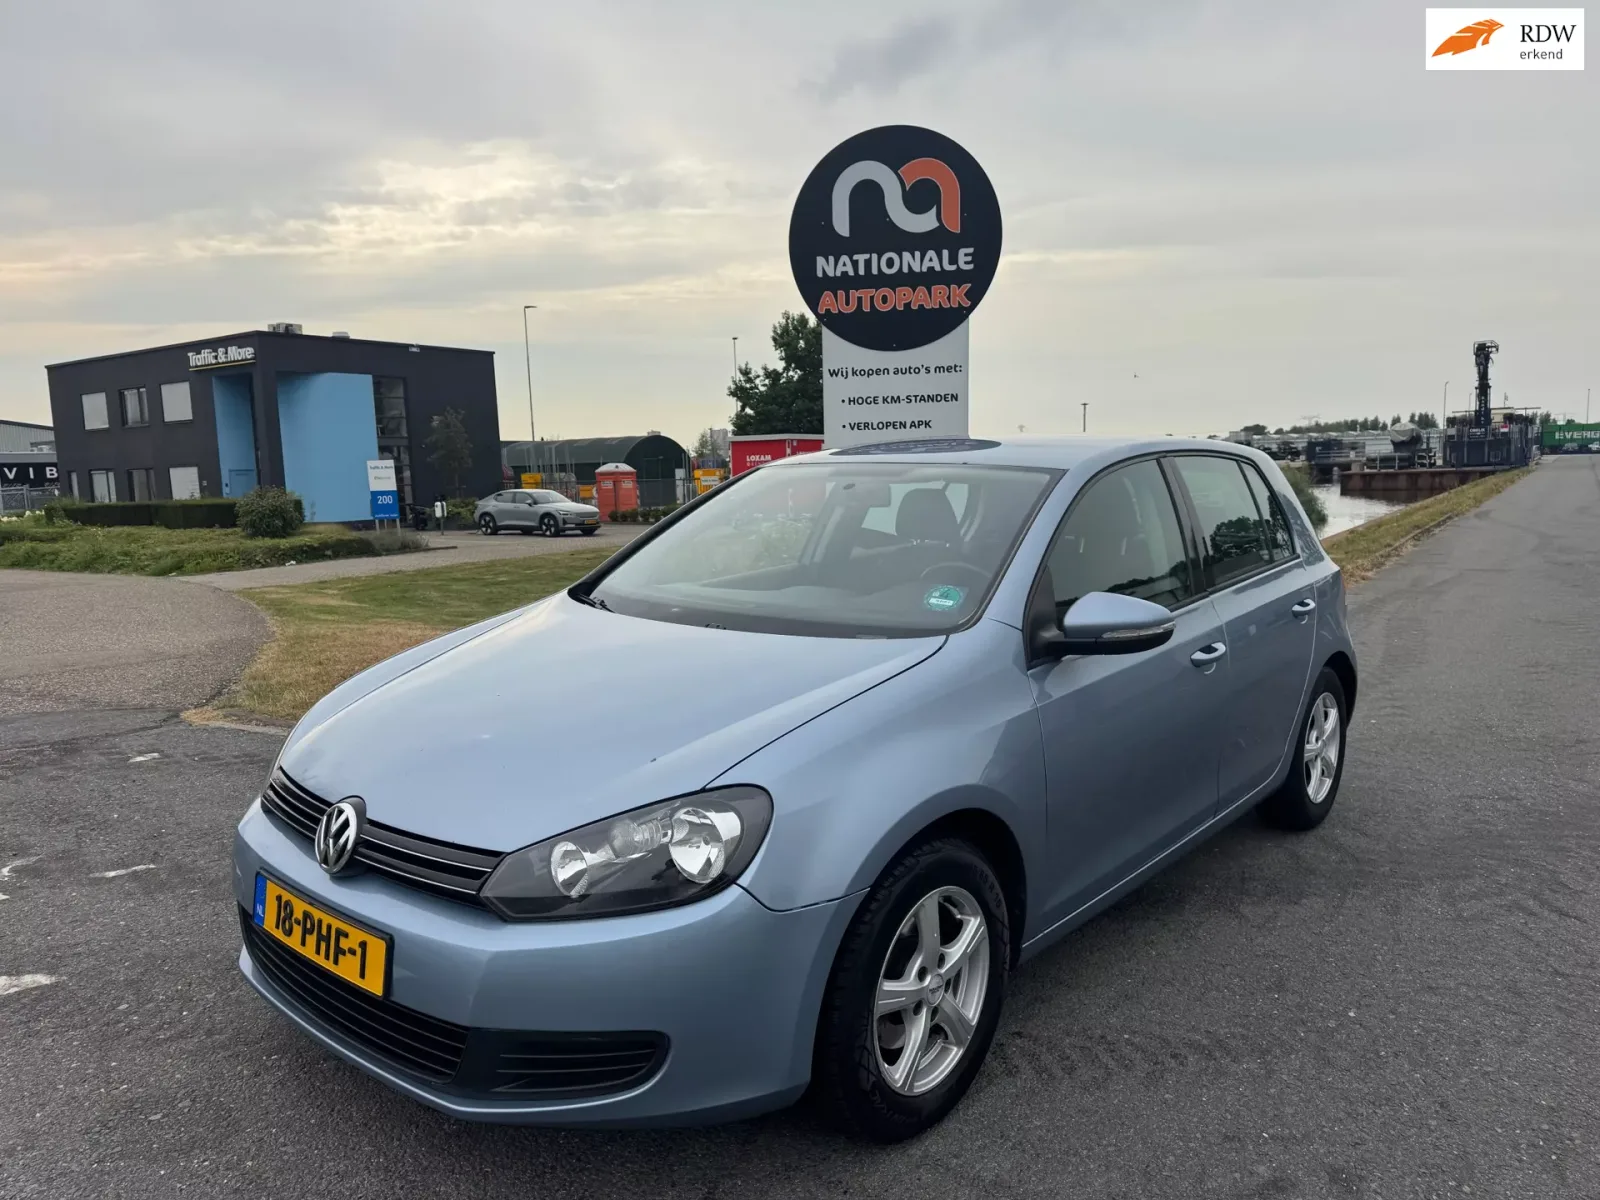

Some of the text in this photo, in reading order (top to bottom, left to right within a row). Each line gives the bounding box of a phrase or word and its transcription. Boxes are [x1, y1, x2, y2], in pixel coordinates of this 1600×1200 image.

[816, 247, 975, 278] NATIONALE
[817, 283, 972, 315] AUTOPARK
[187, 348, 217, 367] Traffic
[227, 345, 255, 361] More
[828, 363, 963, 379] Wij kopen auto's met:
[848, 393, 959, 406] HOGE KM-STANDEN
[848, 419, 932, 431] VERLOPEN APK
[377, 495, 393, 504] 200
[274, 893, 368, 980] 18-PHF-1
